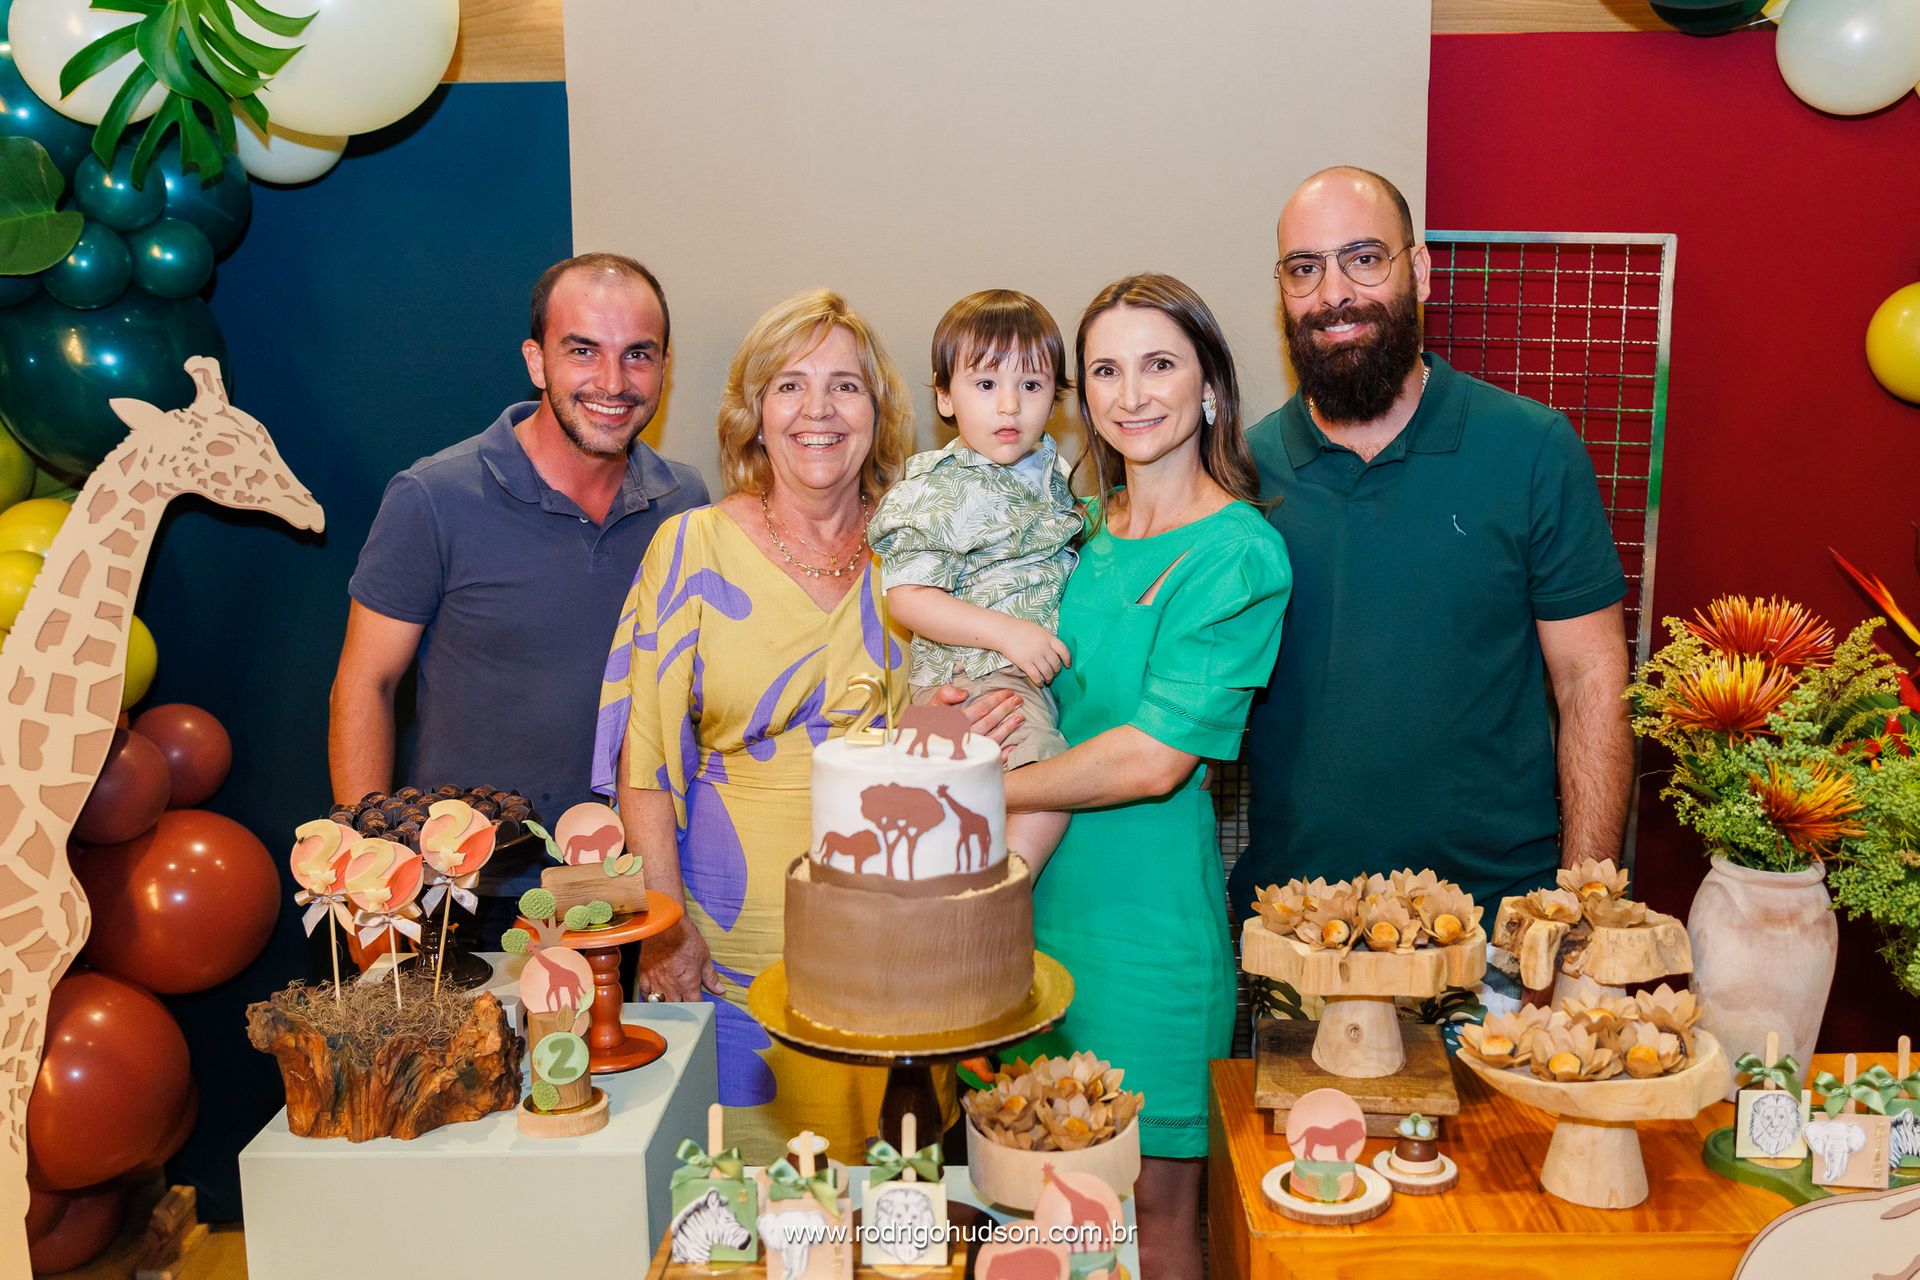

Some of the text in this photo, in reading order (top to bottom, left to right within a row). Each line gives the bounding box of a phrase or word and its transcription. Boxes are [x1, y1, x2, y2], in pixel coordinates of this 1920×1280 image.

[845, 674, 887, 747] 2
[295, 819, 342, 880] 2
[427, 799, 474, 854] 2
[346, 838, 397, 894] 2
[548, 1037, 578, 1079] 2
